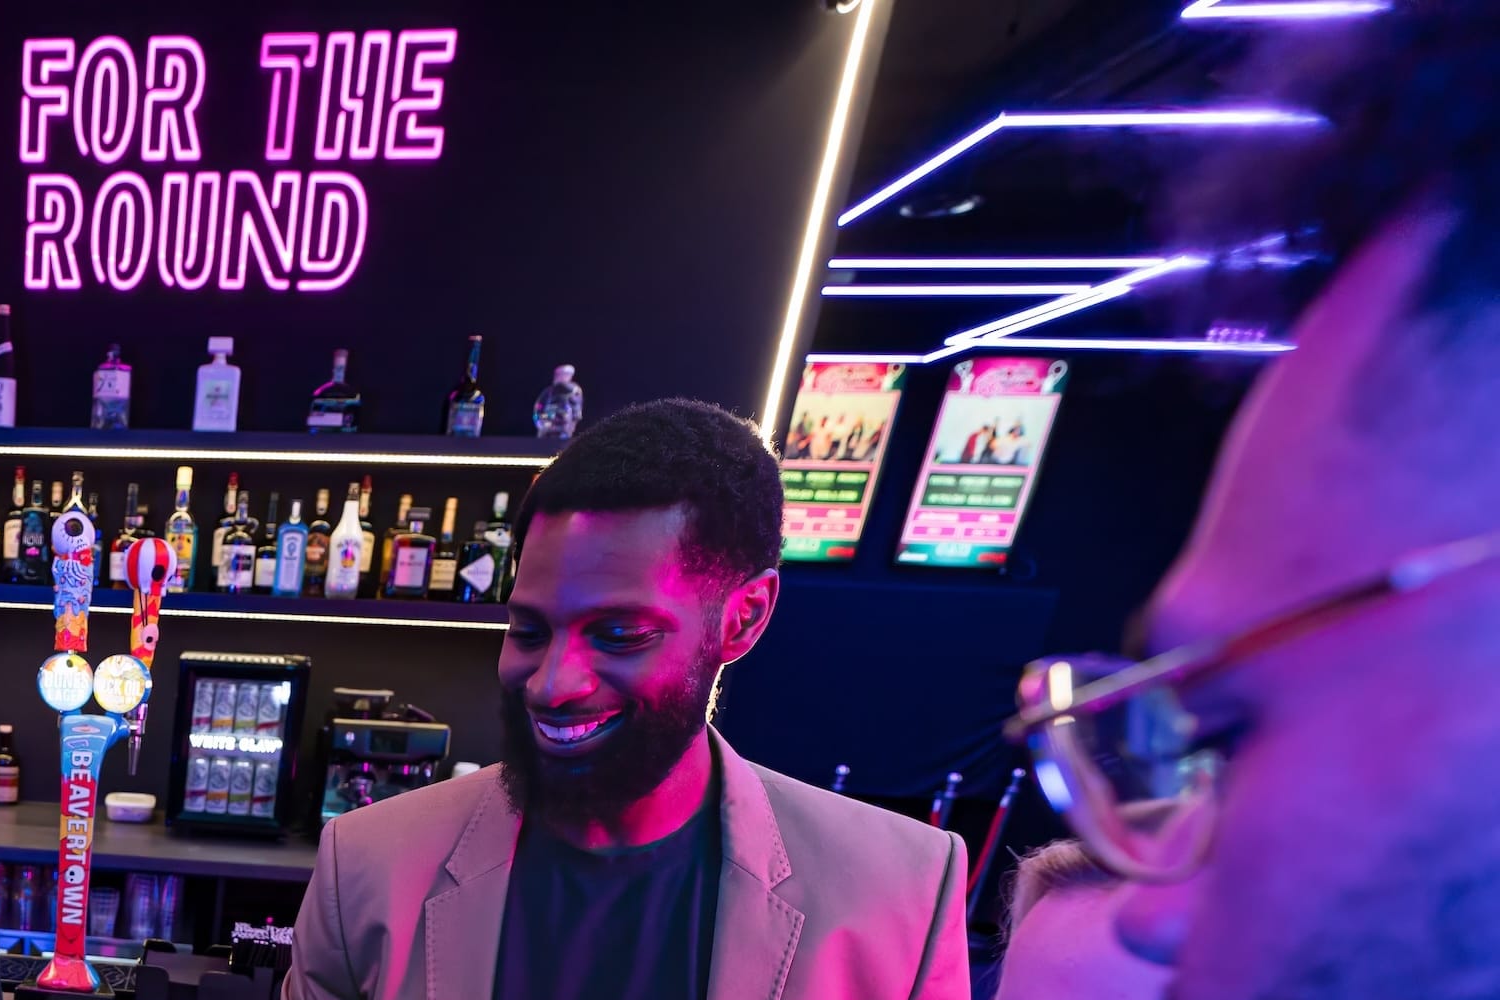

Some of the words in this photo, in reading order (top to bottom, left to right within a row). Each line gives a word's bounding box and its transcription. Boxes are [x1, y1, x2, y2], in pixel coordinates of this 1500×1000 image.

[19, 35, 206, 164] FOR
[260, 28, 458, 160] THE
[24, 171, 369, 291] ROUND
[61, 750, 94, 925] BEAVERTOWN
